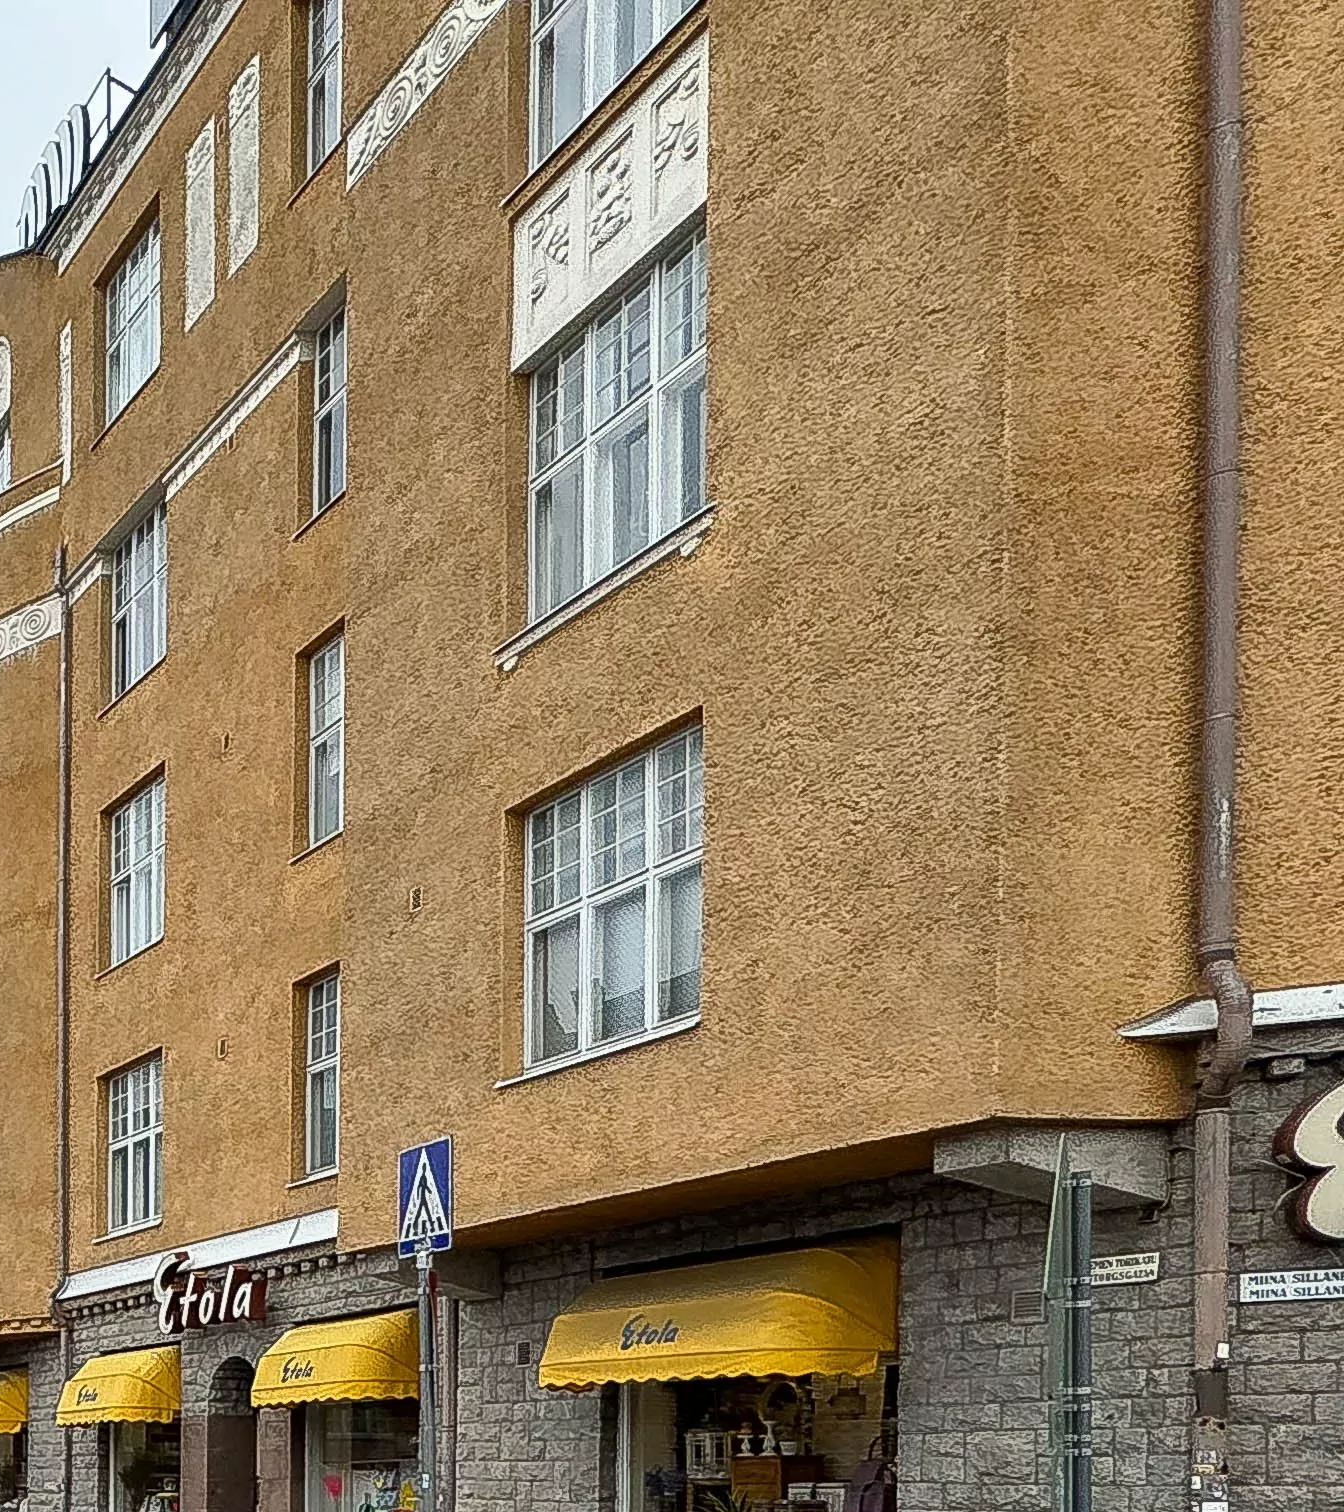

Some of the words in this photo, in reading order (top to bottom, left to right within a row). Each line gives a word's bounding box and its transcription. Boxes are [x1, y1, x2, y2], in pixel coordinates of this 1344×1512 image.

[153, 1252, 253, 1335] Etola
[1247, 1274, 1287, 1286] MIINA
[1249, 1288, 1288, 1299] MIINA
[620, 1313, 681, 1351] Etola
[280, 1356, 315, 1384] Etola
